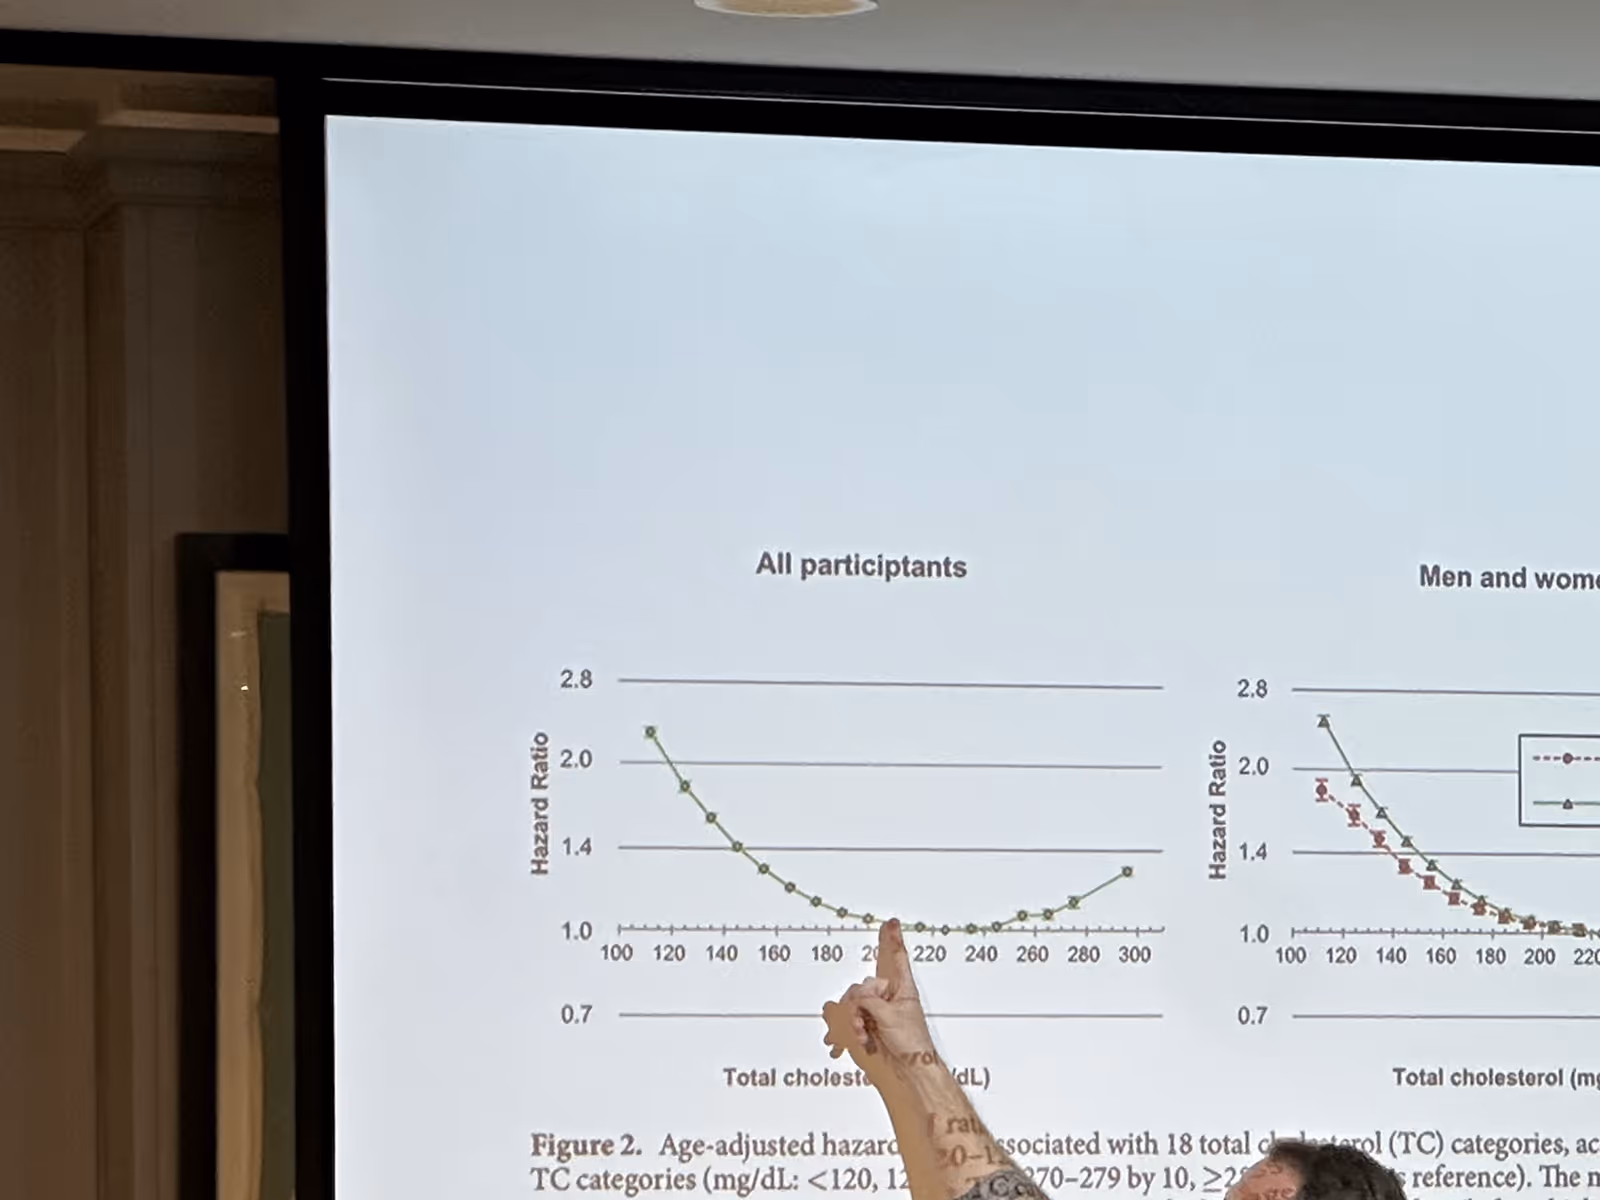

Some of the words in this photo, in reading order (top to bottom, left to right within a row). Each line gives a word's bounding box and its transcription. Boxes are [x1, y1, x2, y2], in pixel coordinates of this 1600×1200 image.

[756, 551, 791, 575] All
[801, 552, 967, 583] participtants
[1420, 564, 1471, 588] Men
[1481, 566, 1526, 589] and
[561, 669, 592, 689] 2.8
[1238, 679, 1267, 698] 2.8
[530, 732, 549, 790] Ratio
[560, 749, 592, 768] 2.0
[1208, 740, 1227, 797] Ratio
[1239, 756, 1269, 776] 2.0
[530, 798, 549, 875] Hazard
[563, 837, 592, 856] 1.4
[1208, 803, 1227, 880] Hazard
[1240, 842, 1267, 861] 1.4
[562, 921, 592, 940] 1.0
[1240, 924, 1269, 943] 1.0
[601, 943, 633, 962] 100
[654, 944, 685, 962] 120
[706, 944, 738, 962] 140
[759, 944, 791, 962] 160
[812, 944, 843, 962] 180
[913, 945, 947, 963] 220
[965, 945, 998, 963] 240
[1017, 944, 1049, 963] 260
[1068, 945, 1100, 963] 280
[1119, 945, 1151, 963] 300
[1276, 946, 1306, 964] 100
[1327, 946, 1357, 964] 120
[1377, 947, 1407, 965] 140
[1427, 947, 1456, 965] 160
[1476, 947, 1506, 965] 180
[1524, 947, 1556, 966] 200
[561, 1004, 592, 1024] 0.7
[1238, 1006, 1268, 1025] 0.7
[723, 1067, 776, 1086] Total
[783, 1067, 868, 1088] cholest
[1393, 1067, 1443, 1087] Total
[1450, 1067, 1563, 1087] cholesterol
[531, 1133, 614, 1164] Figure
[620, 1133, 642, 1156] 2.
[659, 1132, 815, 1164] Age-adjusted
[997, 1130, 1100, 1156] sociated
[1107, 1130, 1159, 1156] with
[1168, 1132, 1193, 1156] 18
[1199, 1130, 1250, 1156] total
[1389, 1130, 1443, 1160] (TC)
[1451, 1132, 1569, 1162] categories,
[530, 1167, 570, 1191] TC
[576, 1168, 696, 1198] categories
[703, 1166, 798, 1198] (mg/dL:
[808, 1168, 878, 1193] <120,
[1127, 1164, 1156, 1197] by
[1163, 1166, 1196, 1192] 10,
[1413, 1163, 1532, 1193] reference).
[1539, 1163, 1580, 1188] The
